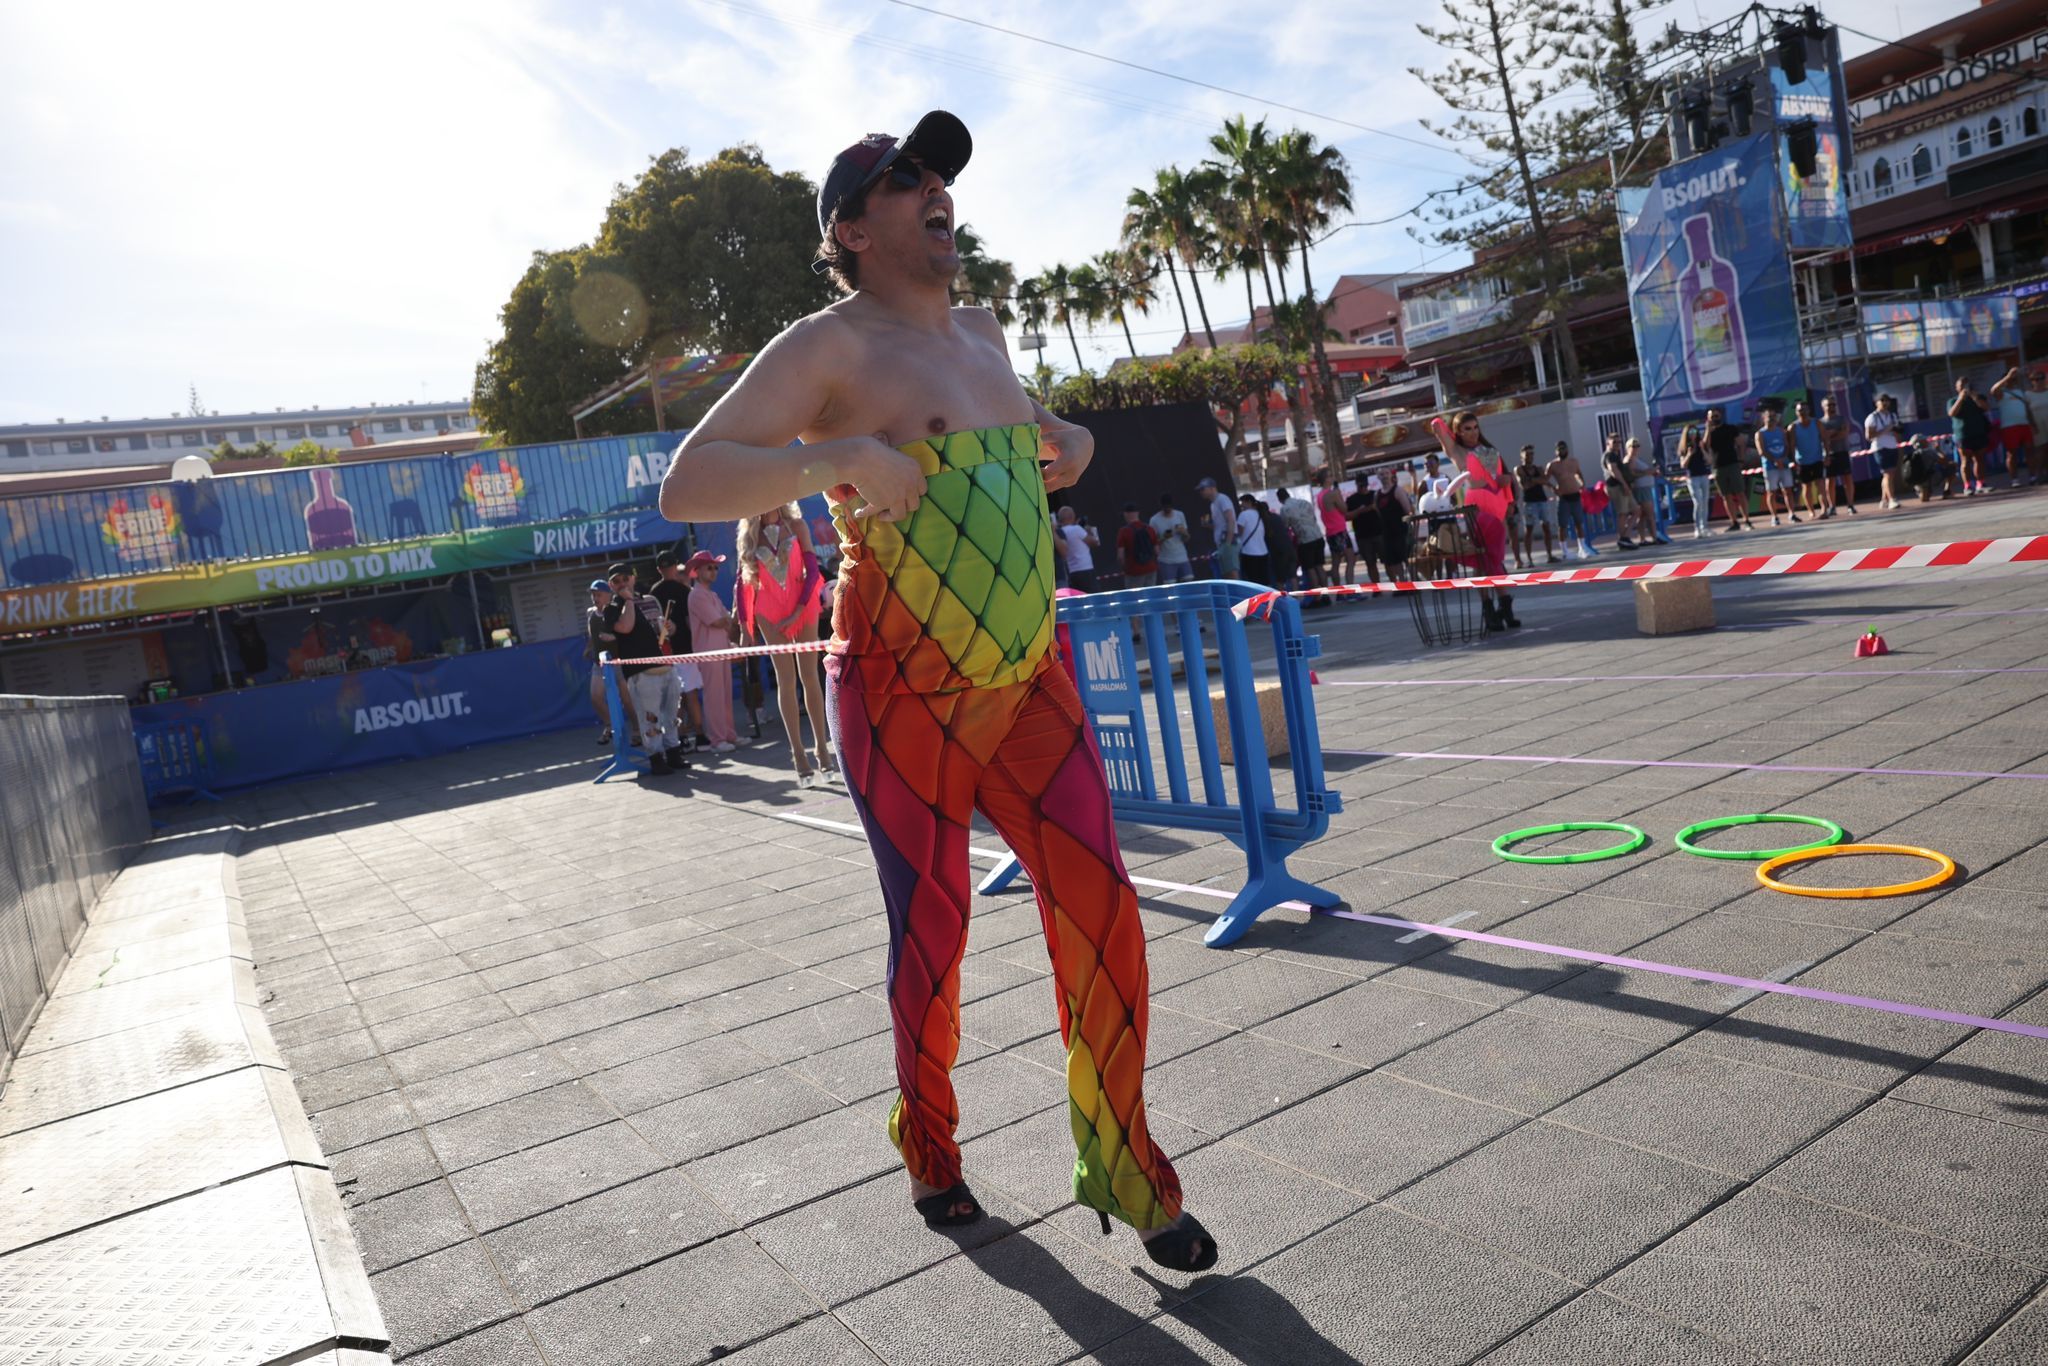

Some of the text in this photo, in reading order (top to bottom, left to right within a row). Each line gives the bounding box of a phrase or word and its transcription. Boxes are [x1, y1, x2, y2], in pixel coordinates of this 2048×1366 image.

[1874, 43, 2021, 116] TANDOORI
[1902, 112, 1958, 136] STEAK
[1661, 161, 1746, 212] BSOLUT.
[533, 518, 639, 555] DRINK HERE
[255, 546, 437, 592] PROUD TO MIX
[77, 583, 139, 616] HERE
[1090, 682, 1128, 692] MASPALOMAS
[354, 691, 472, 735] ABSOLUT.
